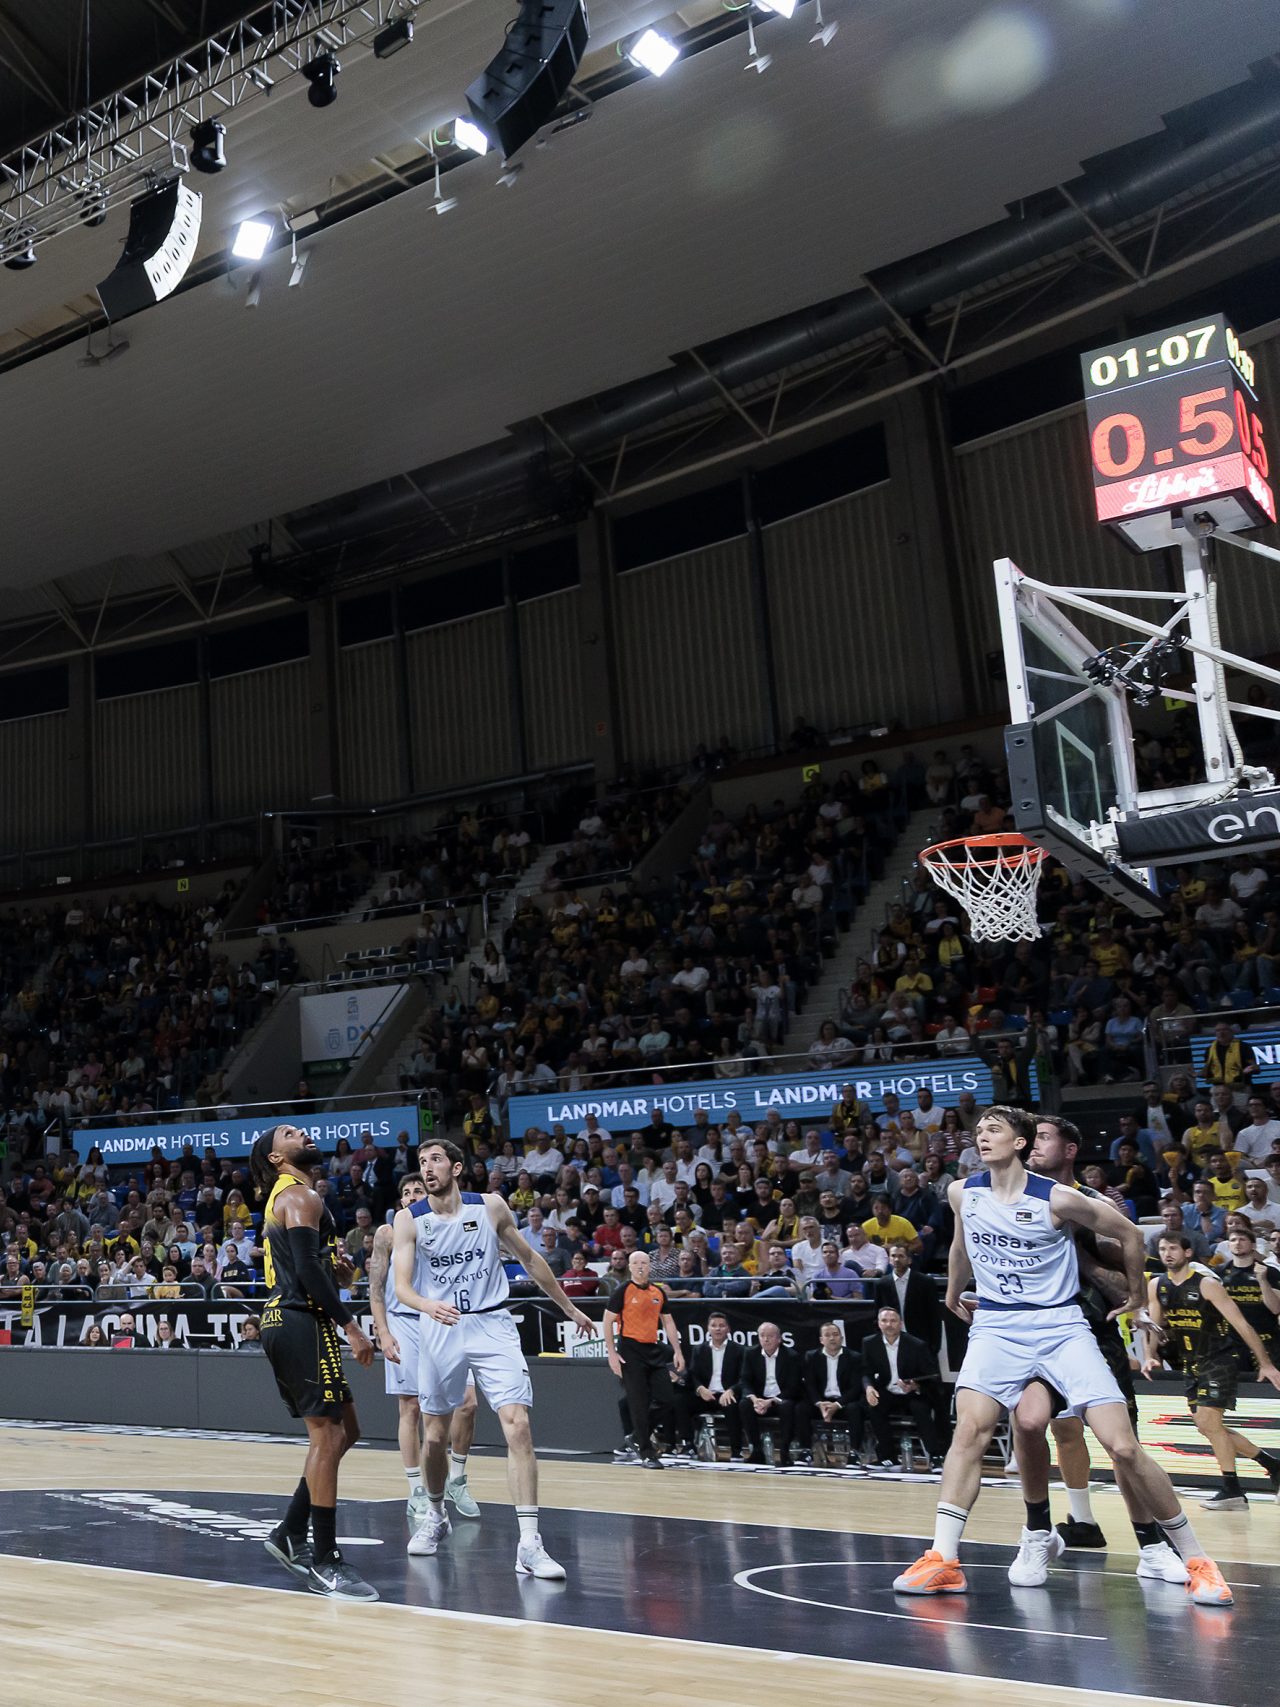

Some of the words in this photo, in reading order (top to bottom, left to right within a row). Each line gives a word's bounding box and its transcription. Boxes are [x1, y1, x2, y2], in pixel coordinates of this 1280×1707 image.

[1090, 324, 1217, 387] 01:07
[1091, 386, 1234, 478] 0.5
[548, 1098, 648, 1122] LANDMAR
[652, 1091, 738, 1114] HOTELS
[879, 1071, 978, 1096] HOTELS
[325, 1120, 391, 1140] HOTELS
[171, 1132, 230, 1149] HOTELS
[972, 1231, 1022, 1249] asisa
[430, 1250, 474, 1268] asisa
[972, 1252, 1043, 1268] JOVENTUT
[433, 1267, 491, 1285] JOVENTUT
[996, 1273, 1024, 1296] 23
[453, 1289, 471, 1312] 16
